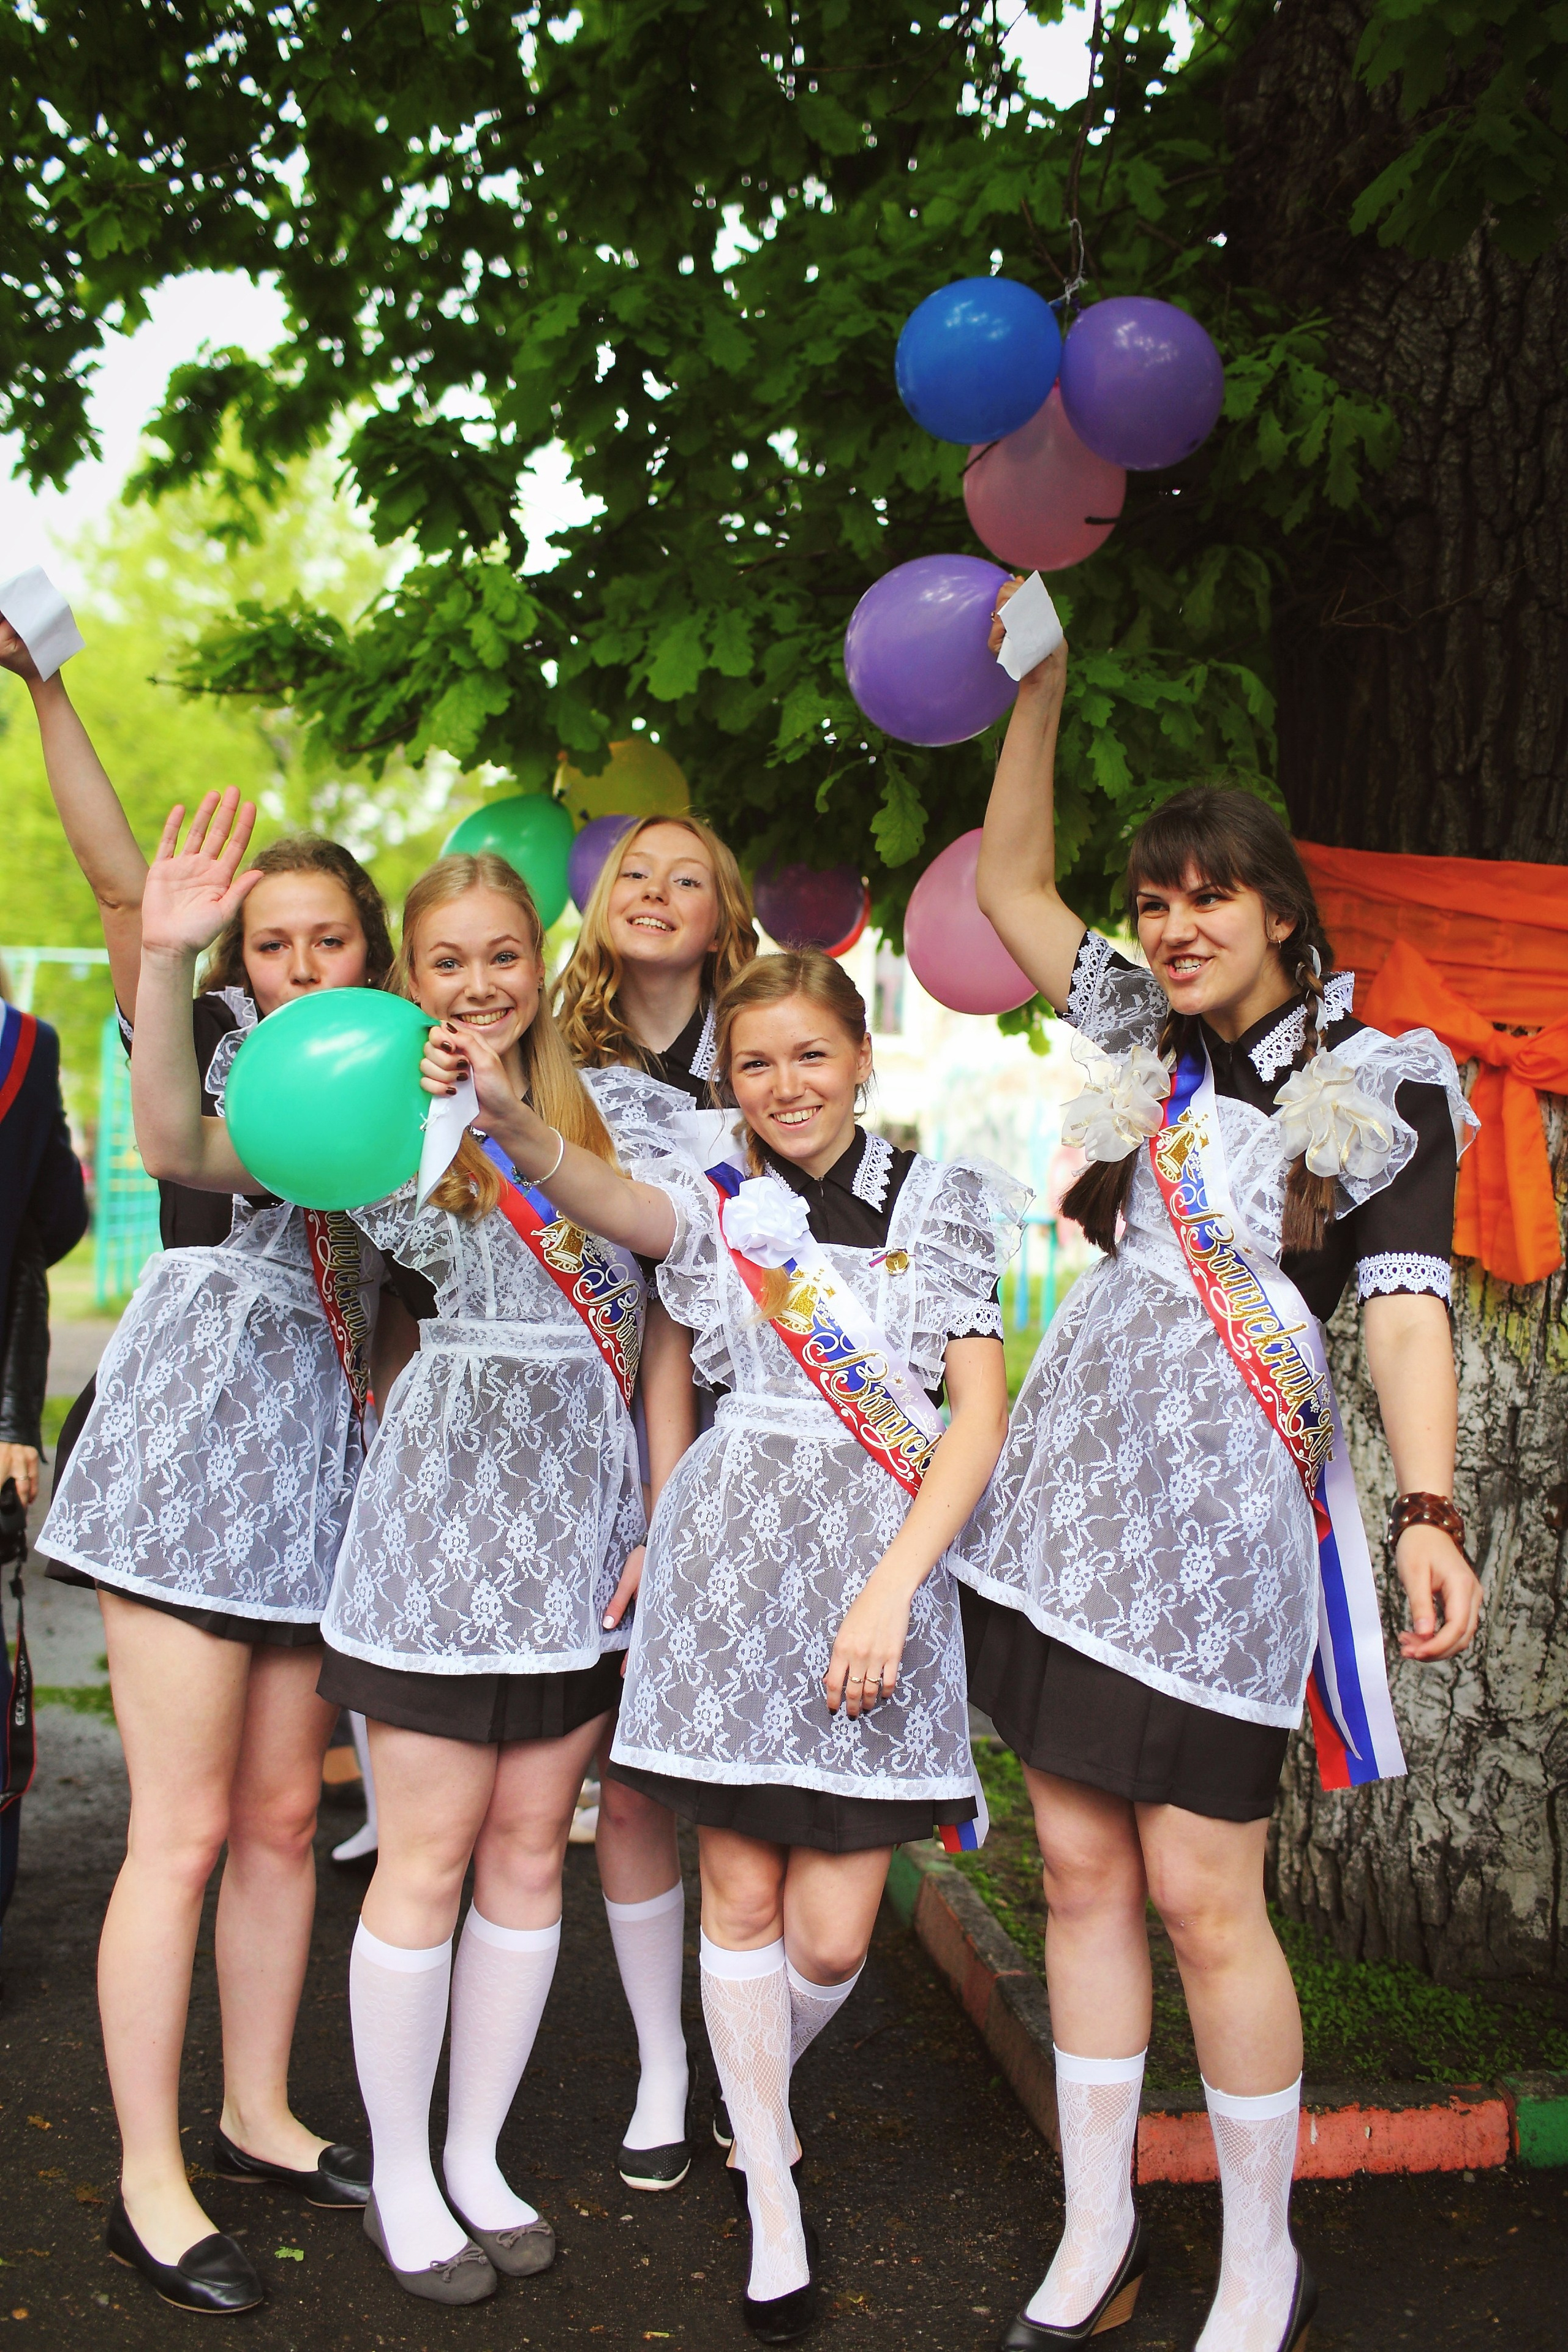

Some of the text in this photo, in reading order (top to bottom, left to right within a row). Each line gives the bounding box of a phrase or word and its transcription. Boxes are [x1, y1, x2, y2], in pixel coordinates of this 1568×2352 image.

[317, 1210, 374, 1373] ыпускник
[1170, 1184, 1326, 1438] Выпускник
[802, 1332, 943, 1479] Выпуск
